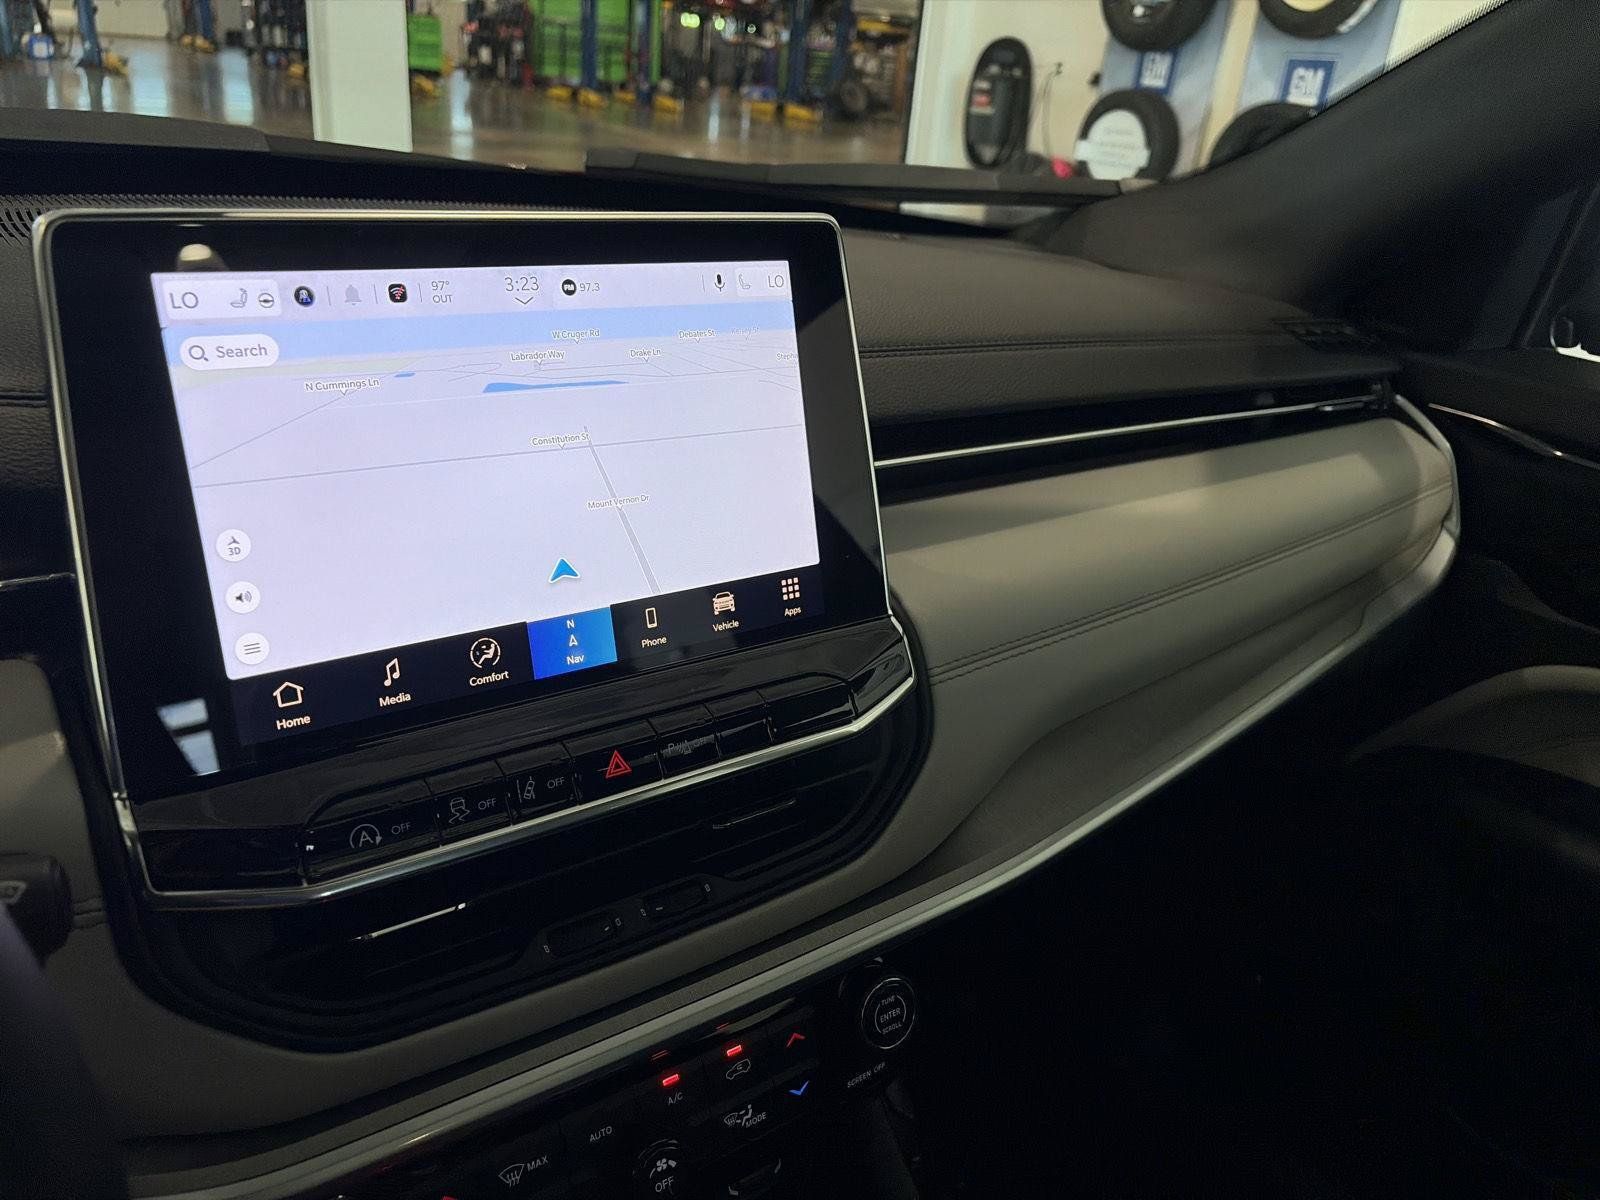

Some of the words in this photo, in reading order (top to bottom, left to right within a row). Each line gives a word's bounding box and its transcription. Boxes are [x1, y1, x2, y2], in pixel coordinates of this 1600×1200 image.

[432, 281, 450, 291] 97°
[505, 277, 539, 292] 3:23
[580, 283, 600, 291] 97.3
[768, 275, 784, 288] LO
[171, 292, 199, 309] LO
[433, 294, 452, 304] OUT
[562, 330, 588, 339] Cruger
[590, 329, 599, 337] Rd
[216, 344, 268, 358] Search
[511, 351, 546, 361] Labrador
[546, 350, 564, 360] Way
[305, 382, 314, 391] N
[315, 379, 365, 391] Cummings
[368, 378, 379, 387] Ln
[532, 434, 579, 446] Constitution
[581, 433, 590, 441] St
[588, 499, 611, 510] Mount
[613, 496, 638, 506] Vernon
[640, 494, 649, 503] Dr
[228, 547, 241, 556] 3D
[784, 607, 801, 616] Apps
[567, 620, 574, 629] N
[713, 620, 739, 631] Vehicle
[641, 635, 666, 648] Phone
[567, 654, 584, 665] Nav
[469, 670, 509, 687] Comfort
[379, 692, 411, 707] Media
[277, 714, 311, 730] Home
[547, 777, 565, 789] OFF
[478, 798, 496, 810] OFF
[391, 822, 411, 835] OFF
[880, 1008, 901, 1023] ENTER
[882, 1022, 902, 1034] SCROLL
[847, 1070, 871, 1088] SCREEN
[874, 1062, 885, 1073] OFF
[668, 1092, 684, 1106] A/C
[746, 1111, 767, 1128] MODE
[589, 1126, 613, 1143] AUTO
[527, 1155, 549, 1172] MAX
[655, 1175, 675, 1192] OFF
